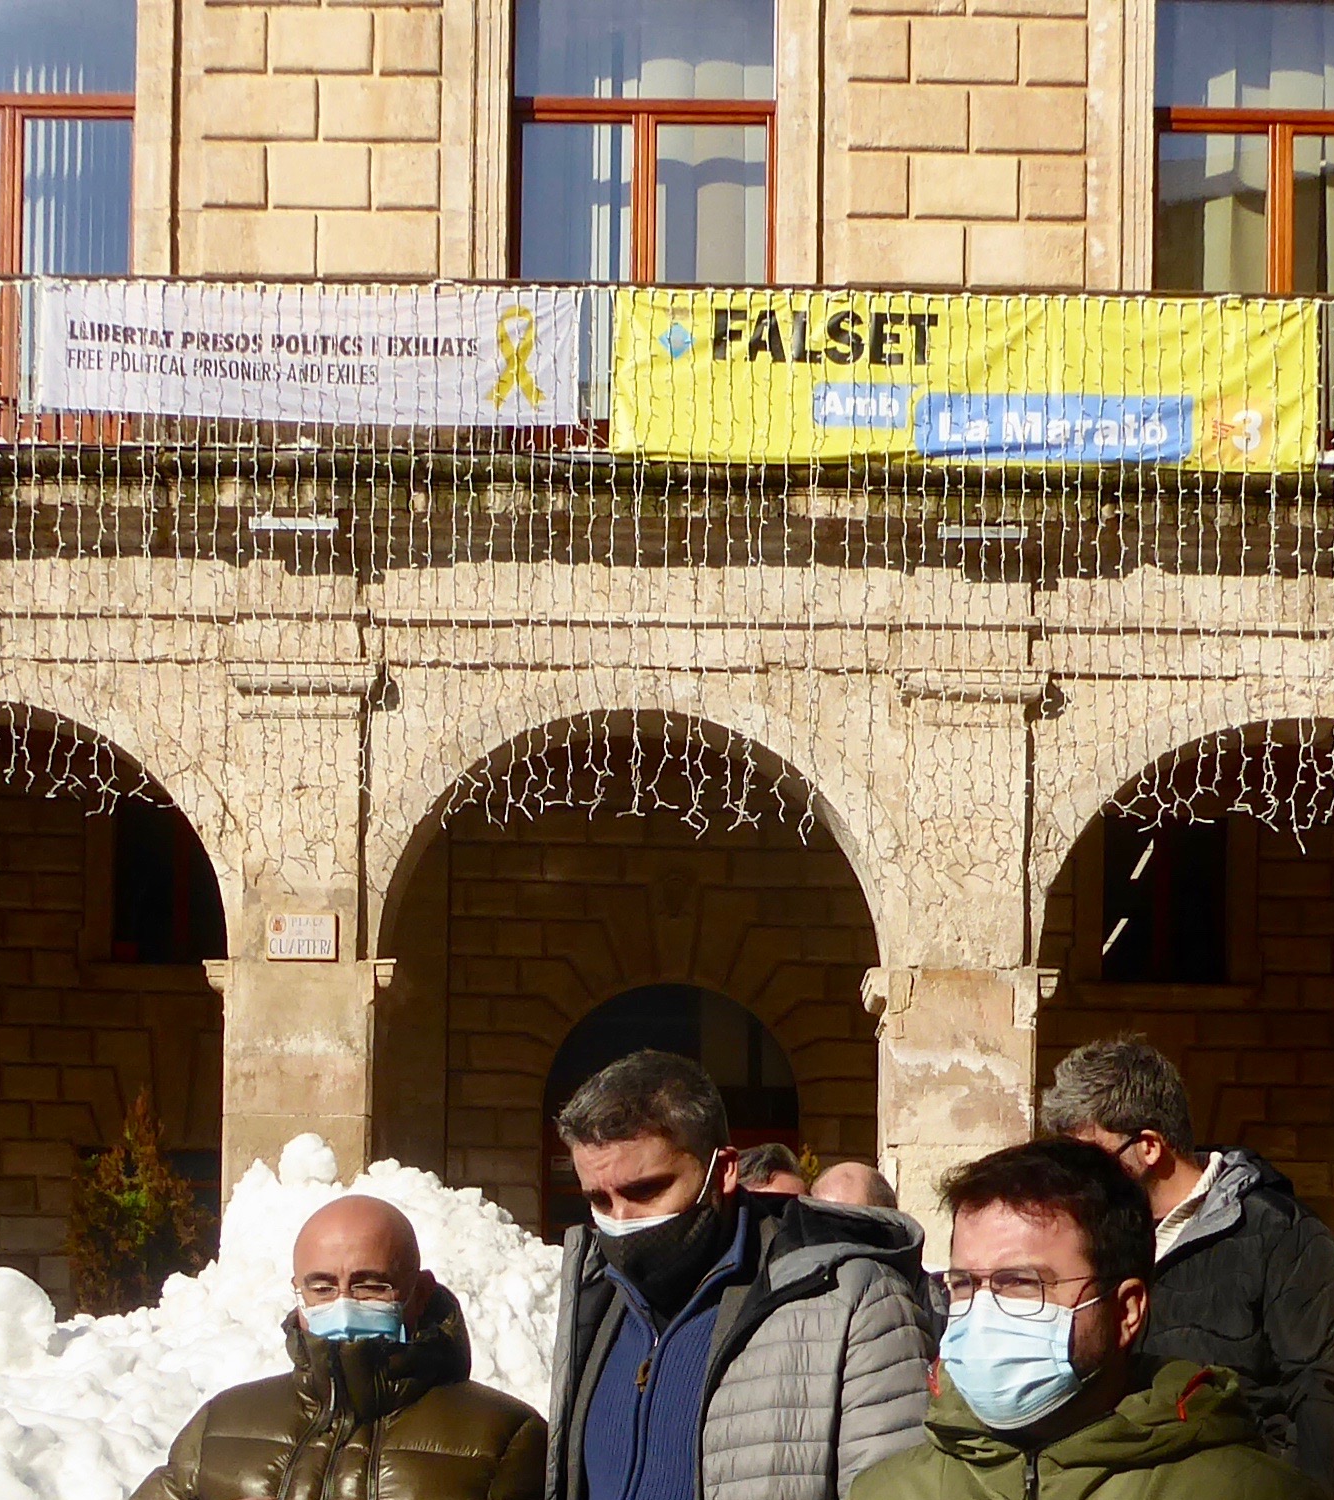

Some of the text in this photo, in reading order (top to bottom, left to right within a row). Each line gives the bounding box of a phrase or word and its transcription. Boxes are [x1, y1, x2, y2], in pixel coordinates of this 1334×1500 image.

[69, 319, 174, 349] LLIBERTAT
[181, 331, 263, 354] PRESOS
[387, 335, 479, 357] EXILIATS
[713, 309, 938, 365] FALSET
[68, 348, 378, 385] FREE POLITICAL PRISONERS AND EXILES
[820, 391, 1168, 447] Amb La Marató
[1231, 409, 1264, 453] 3
